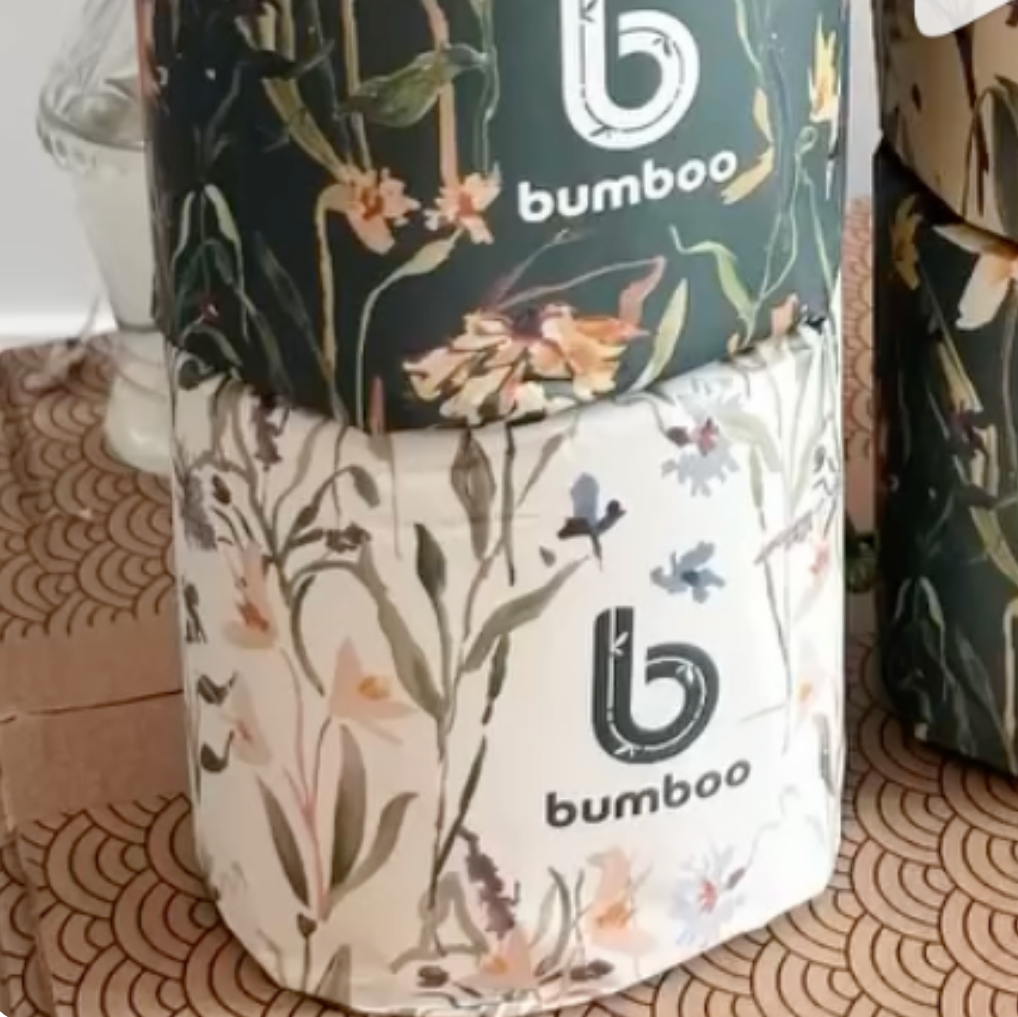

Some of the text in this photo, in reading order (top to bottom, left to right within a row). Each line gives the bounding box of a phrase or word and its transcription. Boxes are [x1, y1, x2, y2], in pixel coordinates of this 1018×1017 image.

[517, 150, 738, 223] bumboo
[591, 606, 720, 764] b
[545, 759, 752, 828] bumboo
